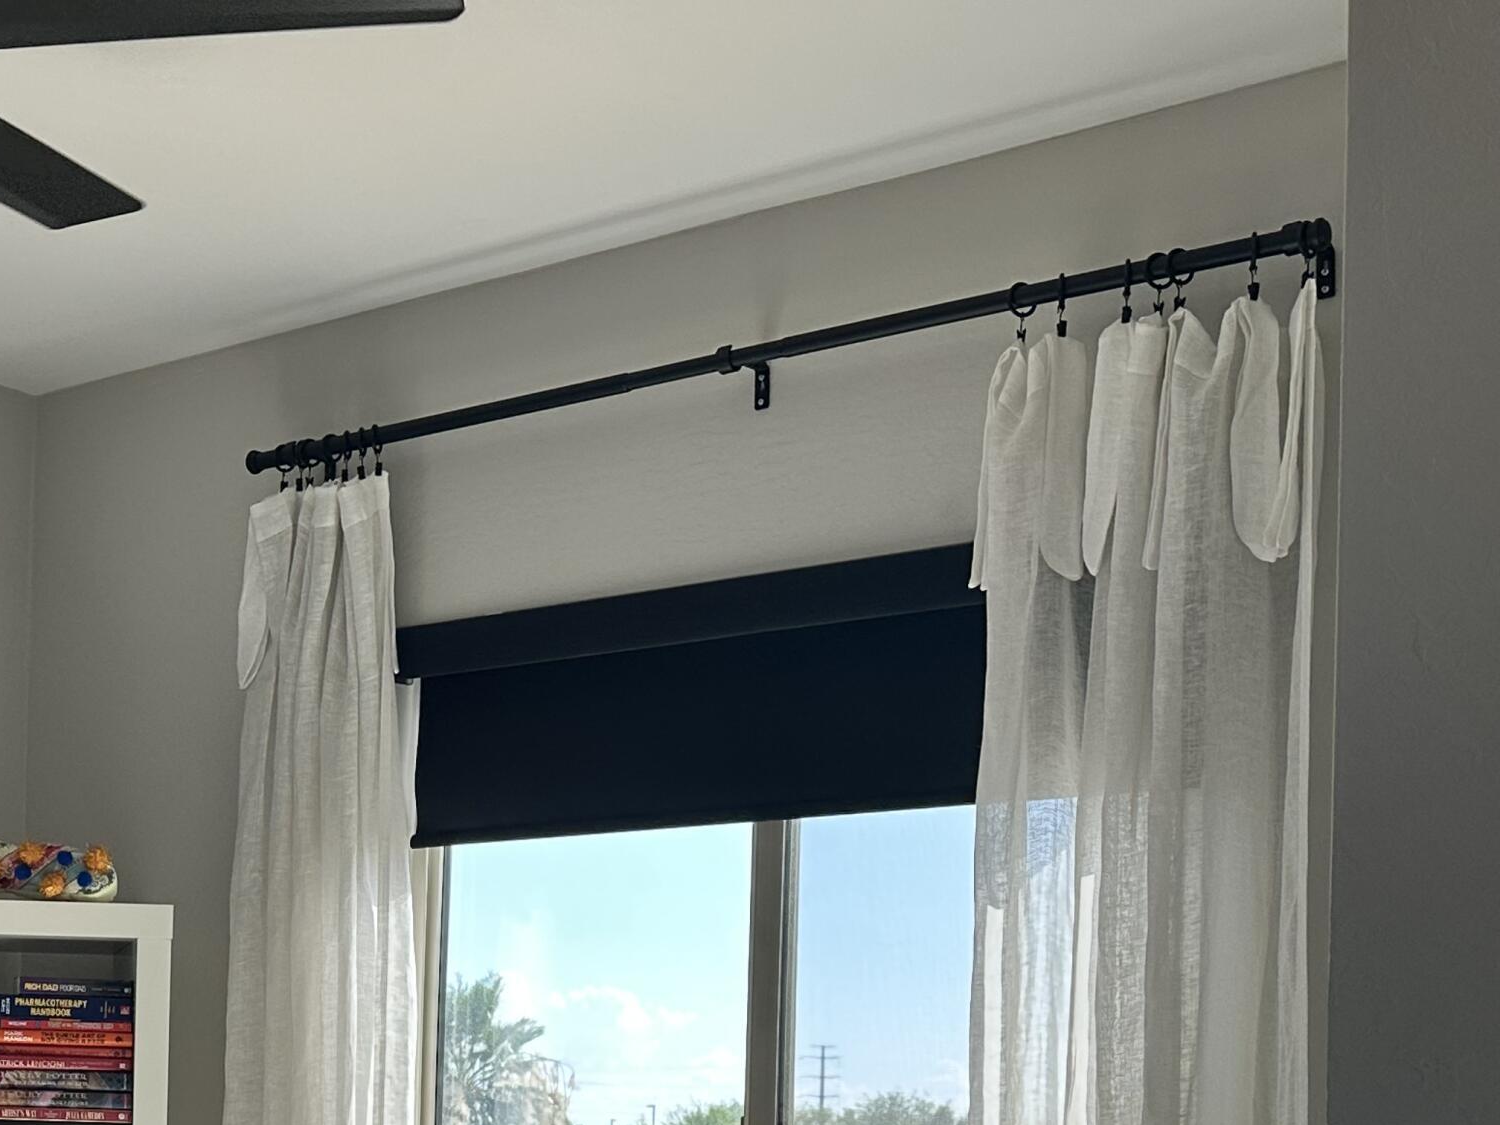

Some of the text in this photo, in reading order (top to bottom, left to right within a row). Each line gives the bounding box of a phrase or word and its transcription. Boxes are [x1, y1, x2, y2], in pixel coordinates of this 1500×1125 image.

[24, 983, 41, 991] RICH
[42, 983, 59, 991] DAD
[14, 997, 88, 1008] PHARMACOTHERAPY
[30, 1007, 72, 1017] HANDBOOK
